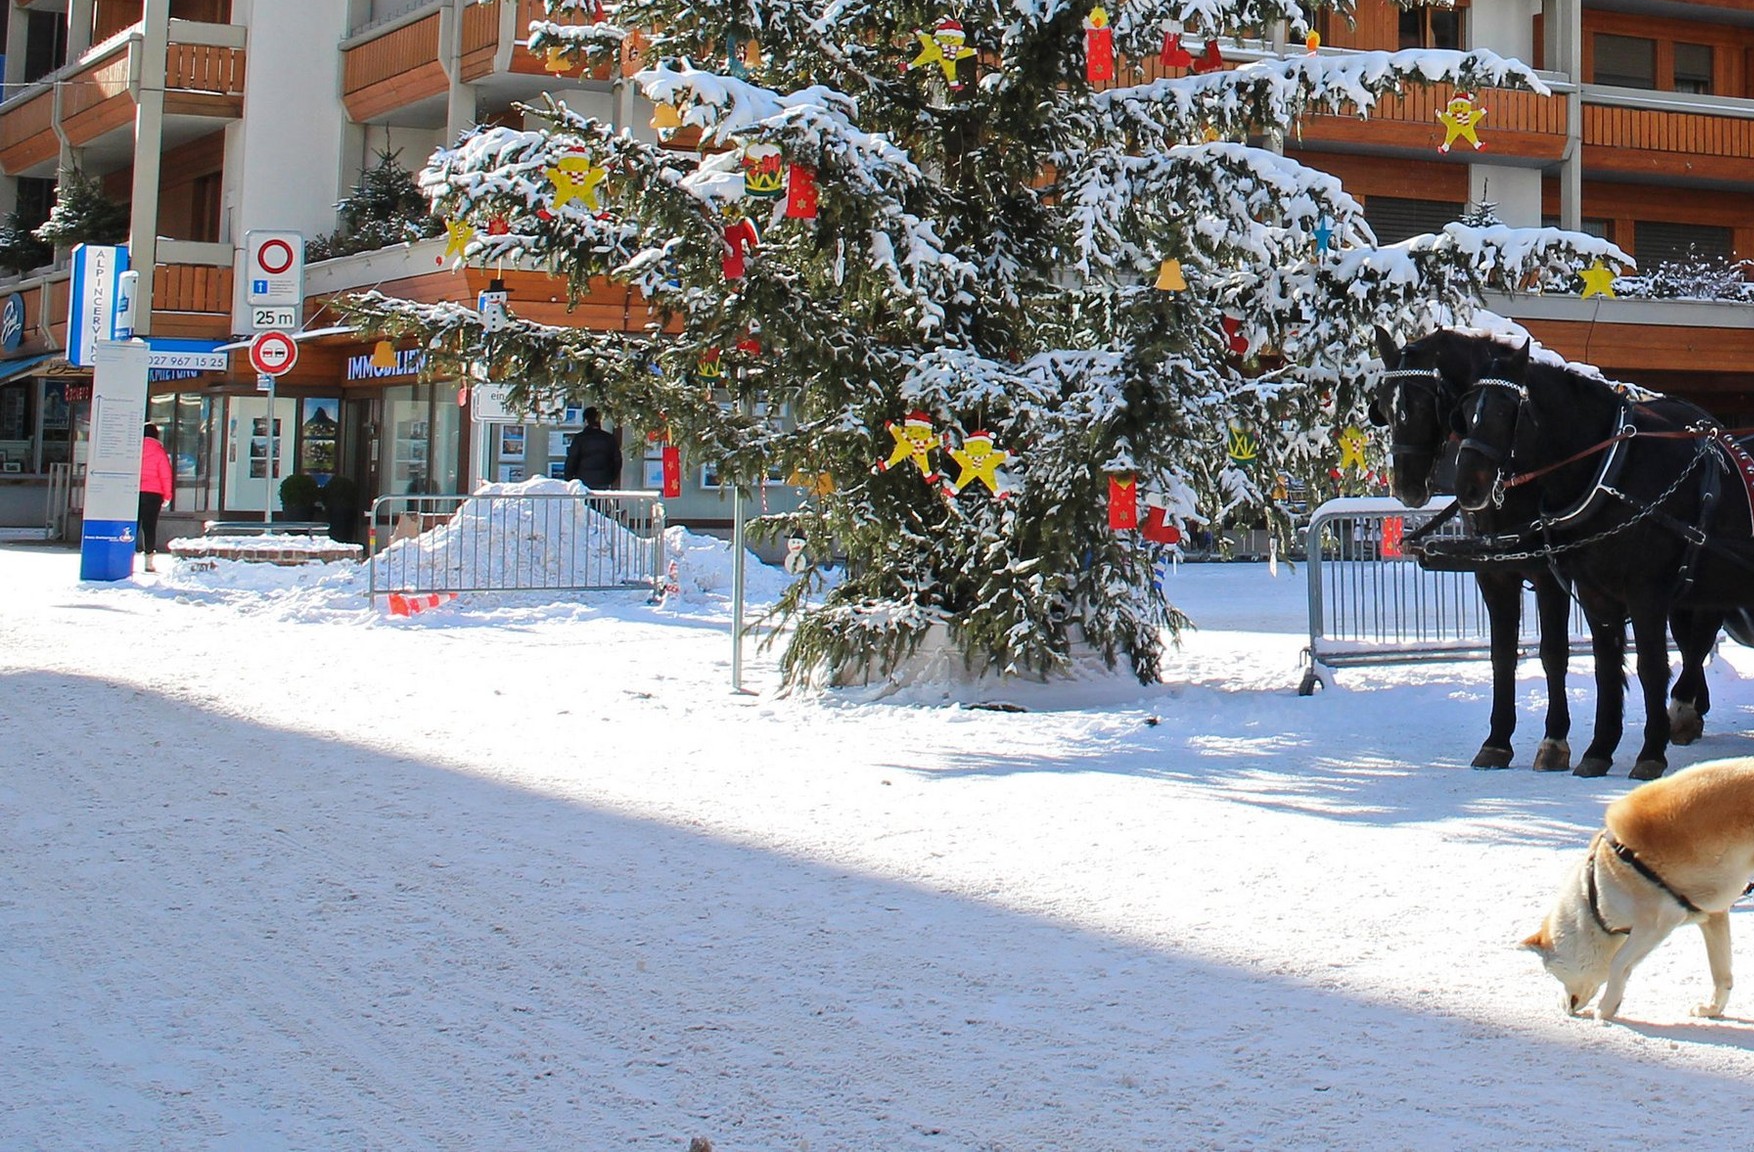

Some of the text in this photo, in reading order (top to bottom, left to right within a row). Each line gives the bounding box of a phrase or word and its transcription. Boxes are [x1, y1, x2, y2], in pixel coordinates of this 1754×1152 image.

[256, 311, 293, 325] 25 m
[170, 356, 191, 367] 967
[196, 357, 207, 367] 15
[210, 358, 224, 368] 25
[347, 348, 427, 381] IMMILIEN
